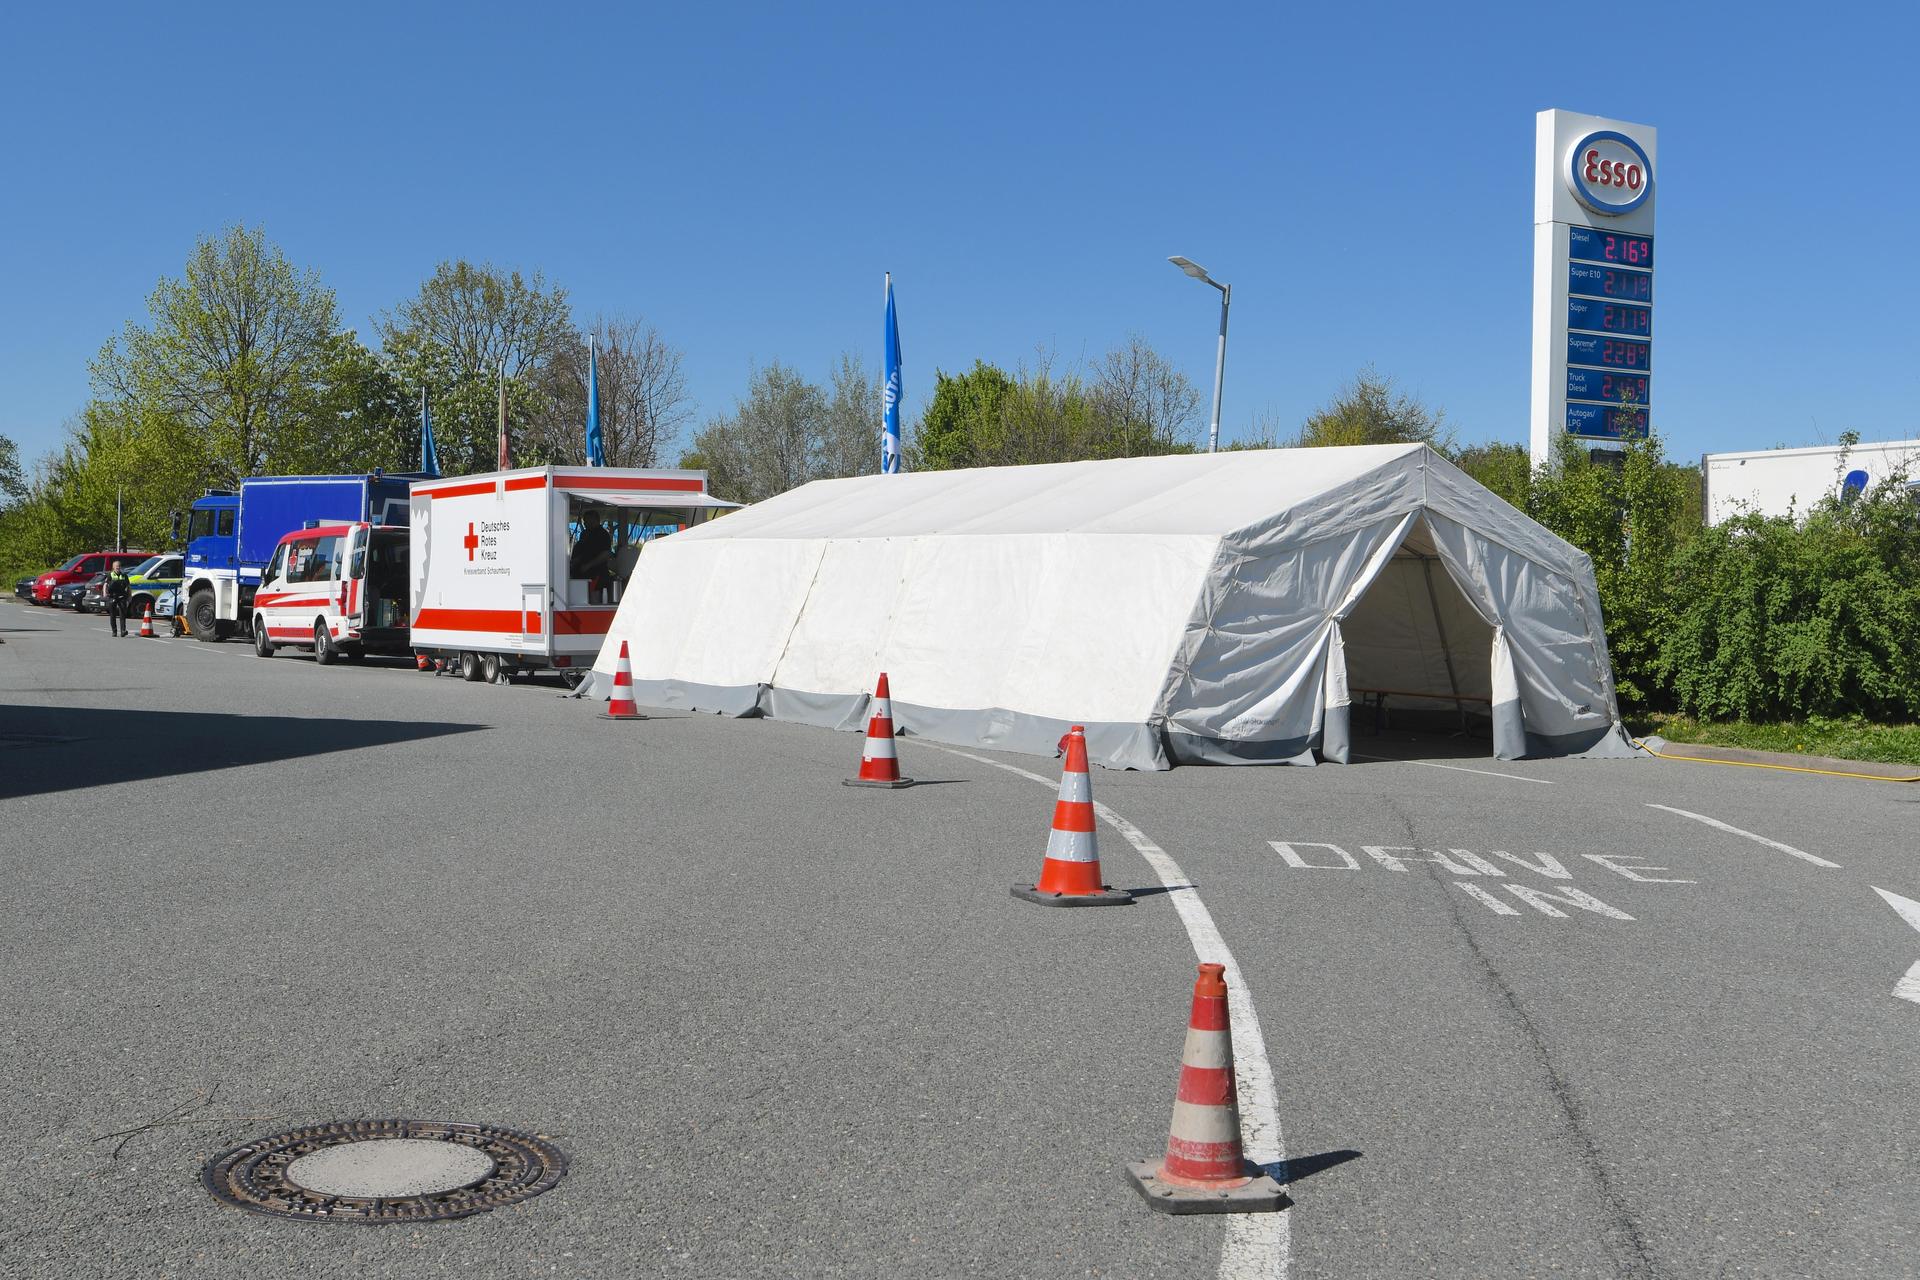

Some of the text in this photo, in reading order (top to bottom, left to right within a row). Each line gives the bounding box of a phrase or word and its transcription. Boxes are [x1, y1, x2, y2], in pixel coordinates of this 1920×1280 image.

[1585, 149, 1641, 190] Esso
[1571, 232, 1590, 242] Diesel
[1571, 268, 1601, 279] Super E10
[1570, 303, 1588, 312] Super
[1569, 372, 1585, 382] Truck
[1568, 383, 1587, 392] Diesel
[1568, 419, 1581, 427] LPG
[481, 520, 510, 532] Deutsches
[481, 535, 497, 546] Rotes
[481, 549, 497, 560] Kreuz
[1266, 840, 1698, 885] DRIVE
[1453, 881, 1638, 920] IN
